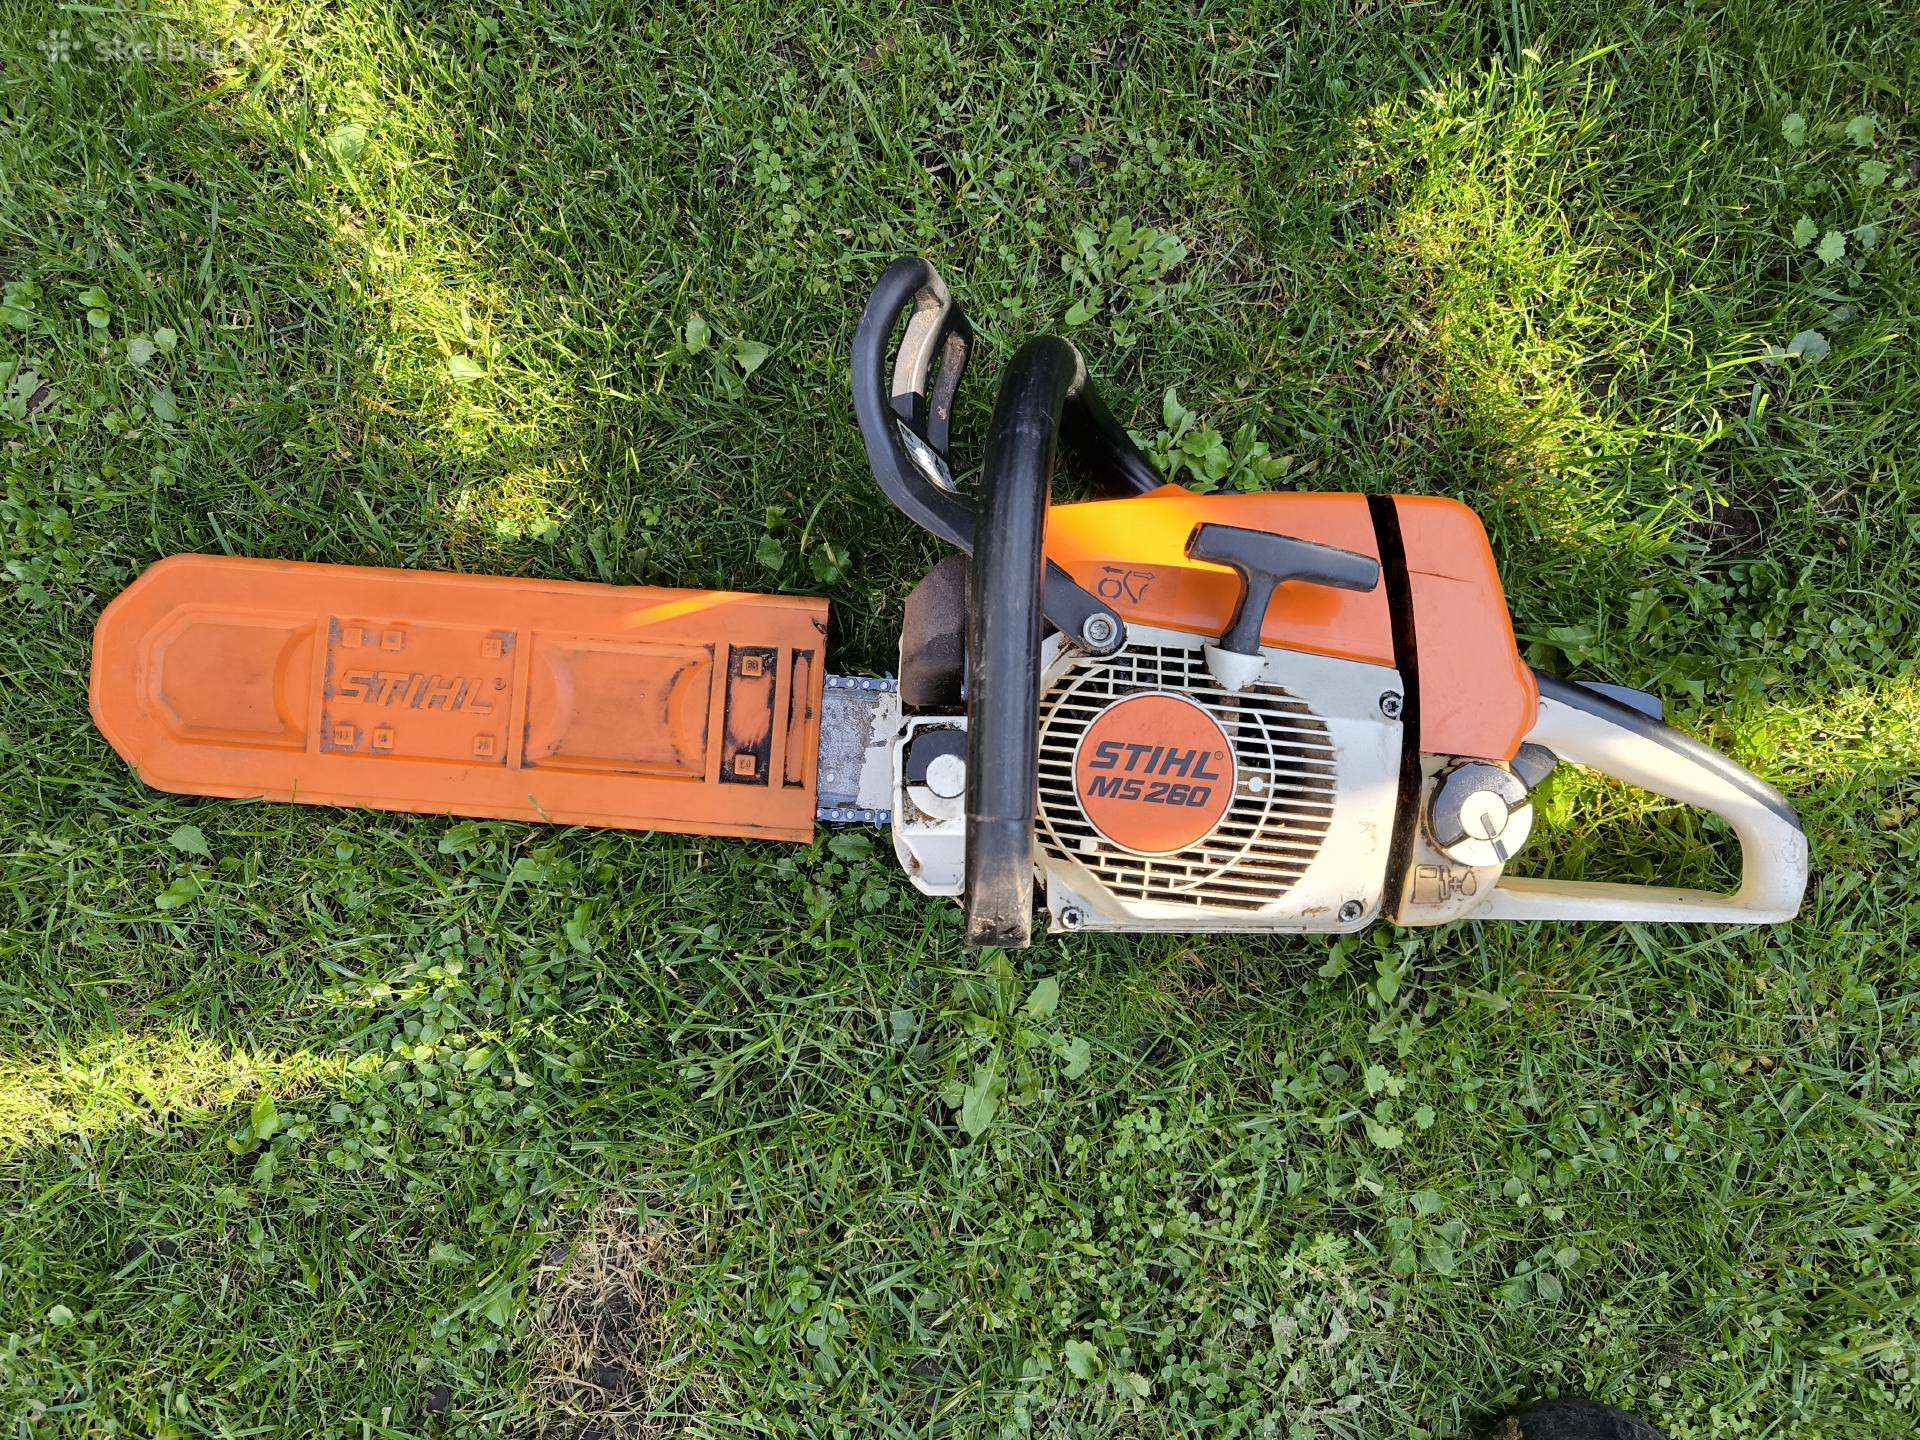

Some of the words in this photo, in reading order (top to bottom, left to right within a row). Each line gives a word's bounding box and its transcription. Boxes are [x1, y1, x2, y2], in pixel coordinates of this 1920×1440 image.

[1088, 740, 1221, 781] STIHL
[1087, 775, 1146, 801] MS
[1143, 781, 1212, 808] 260
